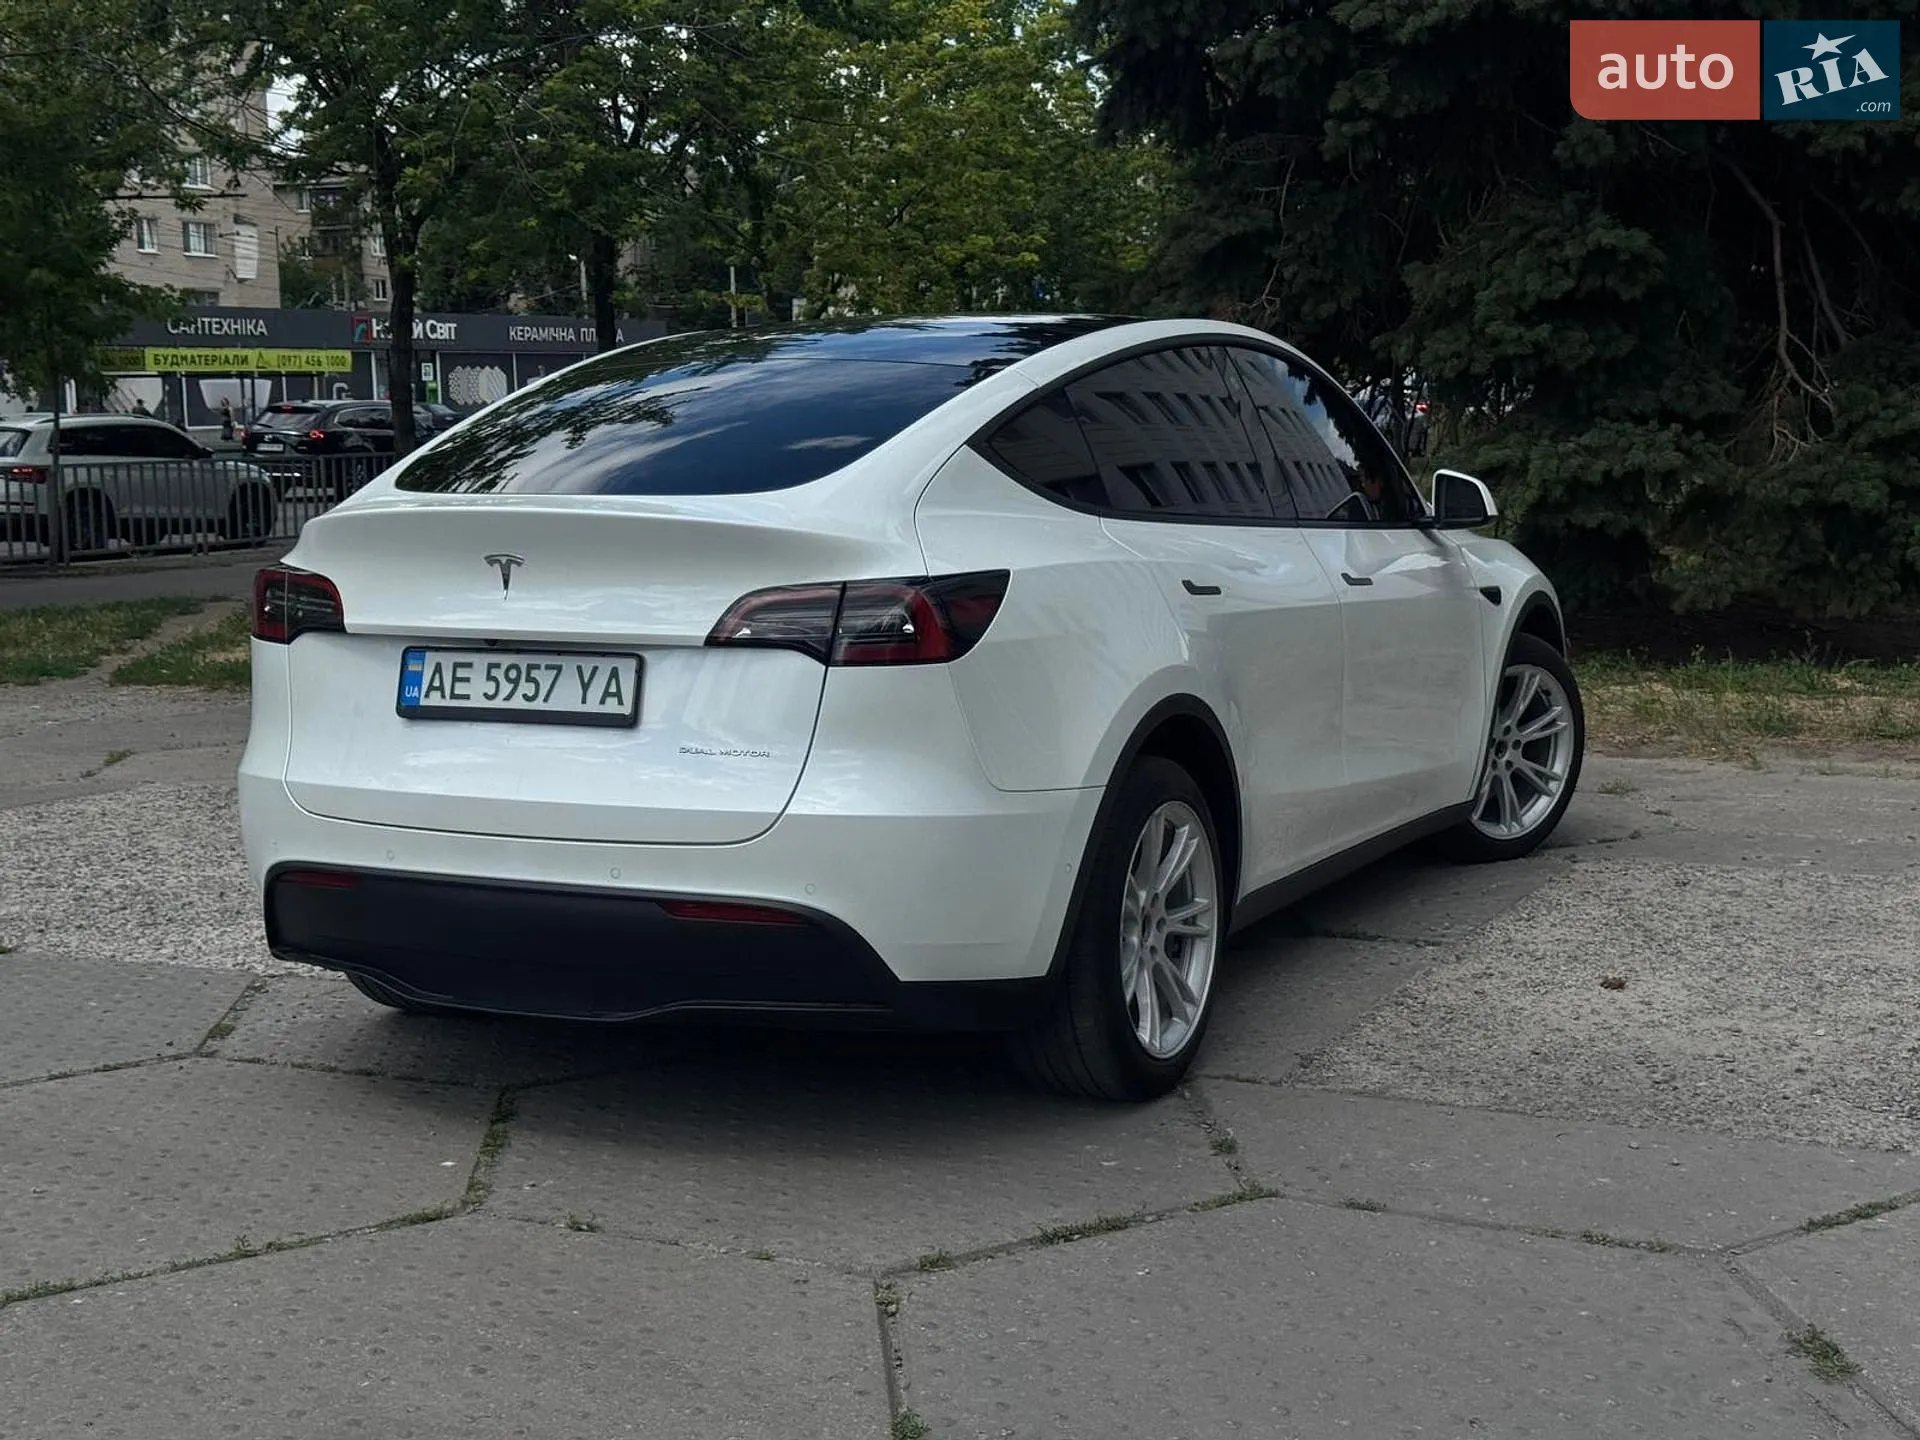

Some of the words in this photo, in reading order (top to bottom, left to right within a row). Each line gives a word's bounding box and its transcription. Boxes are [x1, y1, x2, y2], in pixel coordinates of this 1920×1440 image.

[508, 325, 576, 342] КЕРАМІЧНА
[580, 327, 625, 344] ПЛА
[153, 353, 249, 368] БУДМАТЕРІАЛИ
[305, 355, 323, 367] 456
[423, 661, 474, 701] AE
[482, 662, 564, 703] 5957
[576, 664, 625, 706] YA
[405, 686, 420, 698] UA
[679, 746, 716, 756] DUAL
[719, 748, 770, 759] MOTOR
